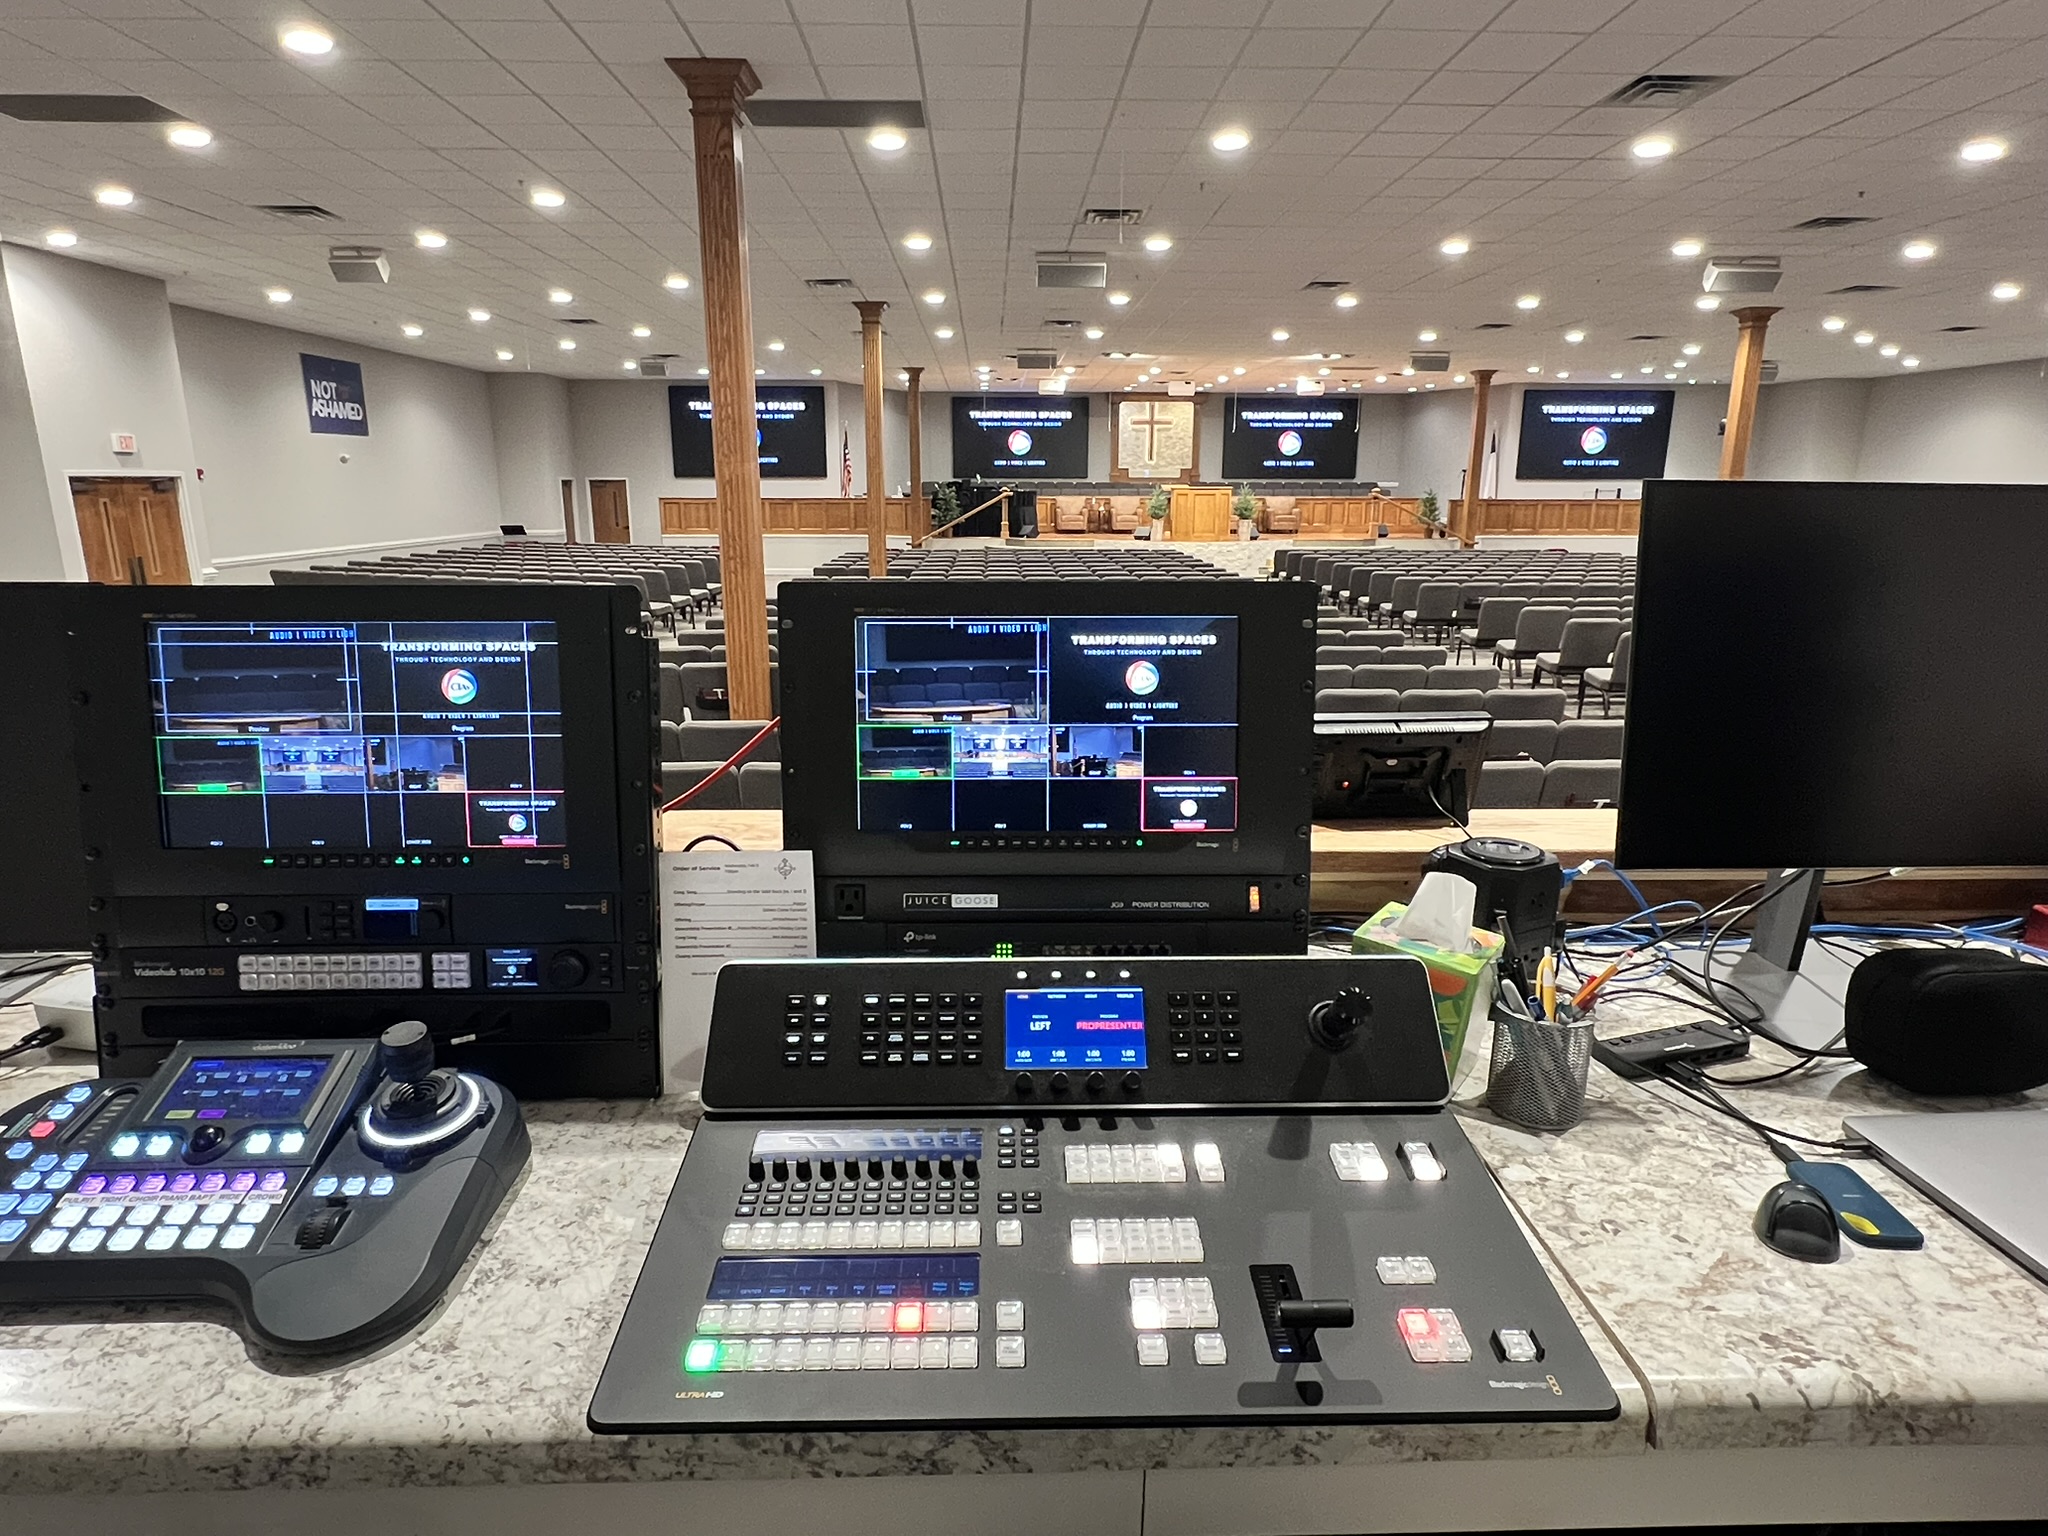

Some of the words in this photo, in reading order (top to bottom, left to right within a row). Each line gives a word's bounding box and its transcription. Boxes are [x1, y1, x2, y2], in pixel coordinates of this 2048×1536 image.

[310, 379, 337, 400] NOT
[311, 398, 363, 421] ASHAMED
[968, 625, 990, 634] AUDIO
[999, 624, 1021, 634] VIDEO
[269, 631, 293, 640] AUDIO
[303, 630, 326, 640] VIDEO
[1070, 635, 1167, 646] TRANSFORMING
[1168, 635, 1218, 646] SPACES
[381, 642, 484, 652] TRANSFORMING
[485, 642, 536, 652] SPACES
[907, 896, 948, 905] JUICE
[954, 896, 995, 905] GOOSE
[1132, 901, 1159, 909] POWER
[1160, 901, 1210, 909] DISTRIBUTION
[915, 933, 937, 941] tp-link
[134, 968, 177, 977] Videohub
[178, 967, 206, 976] 10x10
[1029, 1021, 1052, 1031] LEFT
[1076, 1021, 1144, 1030] PROPRESENTER
[100, 1195, 130, 1203] TIGHT
[129, 1194, 160, 1202] CHOIR
[675, 1391, 705, 1399] ULTRA
[705, 1391, 725, 1399] HD
